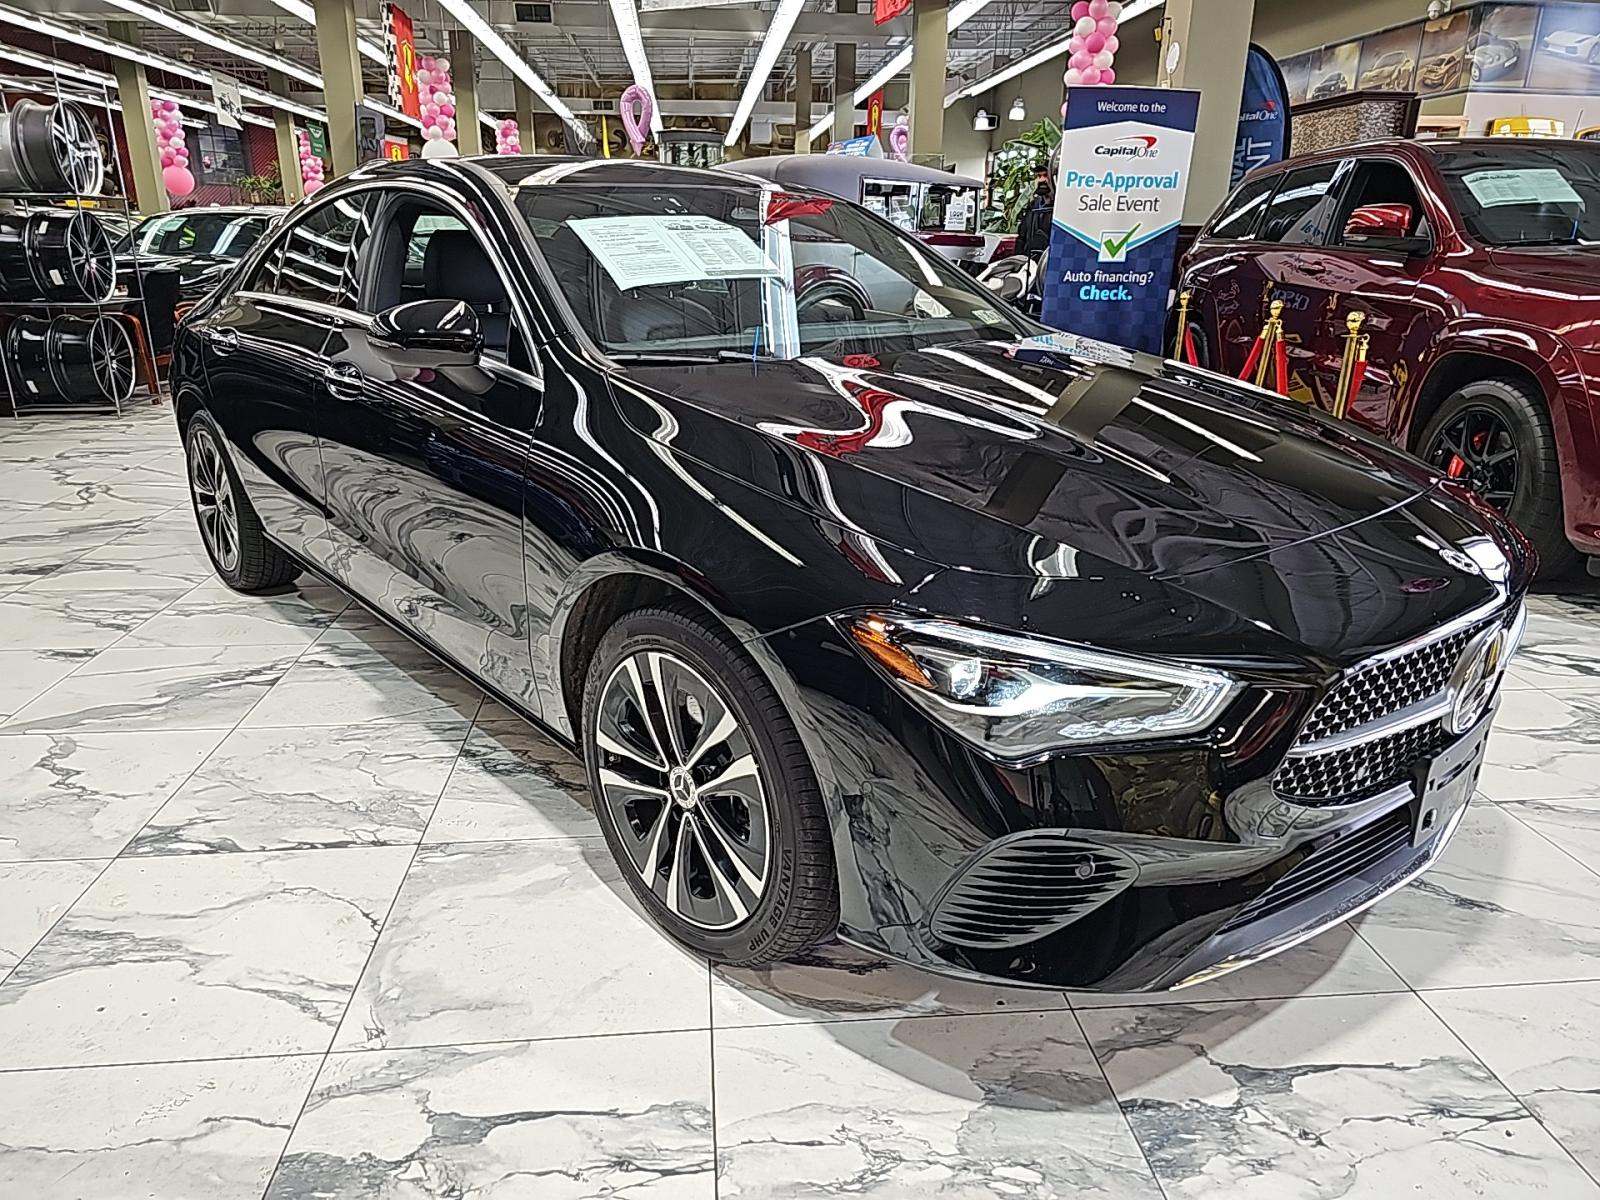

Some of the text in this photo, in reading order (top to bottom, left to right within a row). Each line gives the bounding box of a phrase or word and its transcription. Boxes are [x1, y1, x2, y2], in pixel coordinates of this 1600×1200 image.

[1097, 101, 1167, 113] Welcome to the
[1066, 170, 1179, 193] Pre-Approval
[1079, 194, 1160, 212] Sale Event
[1063, 269, 1154, 286] Auto financing?
[1079, 285, 1133, 300] Check.
[769, 849, 792, 929] VANTAGE
[748, 927, 770, 951] UHP
